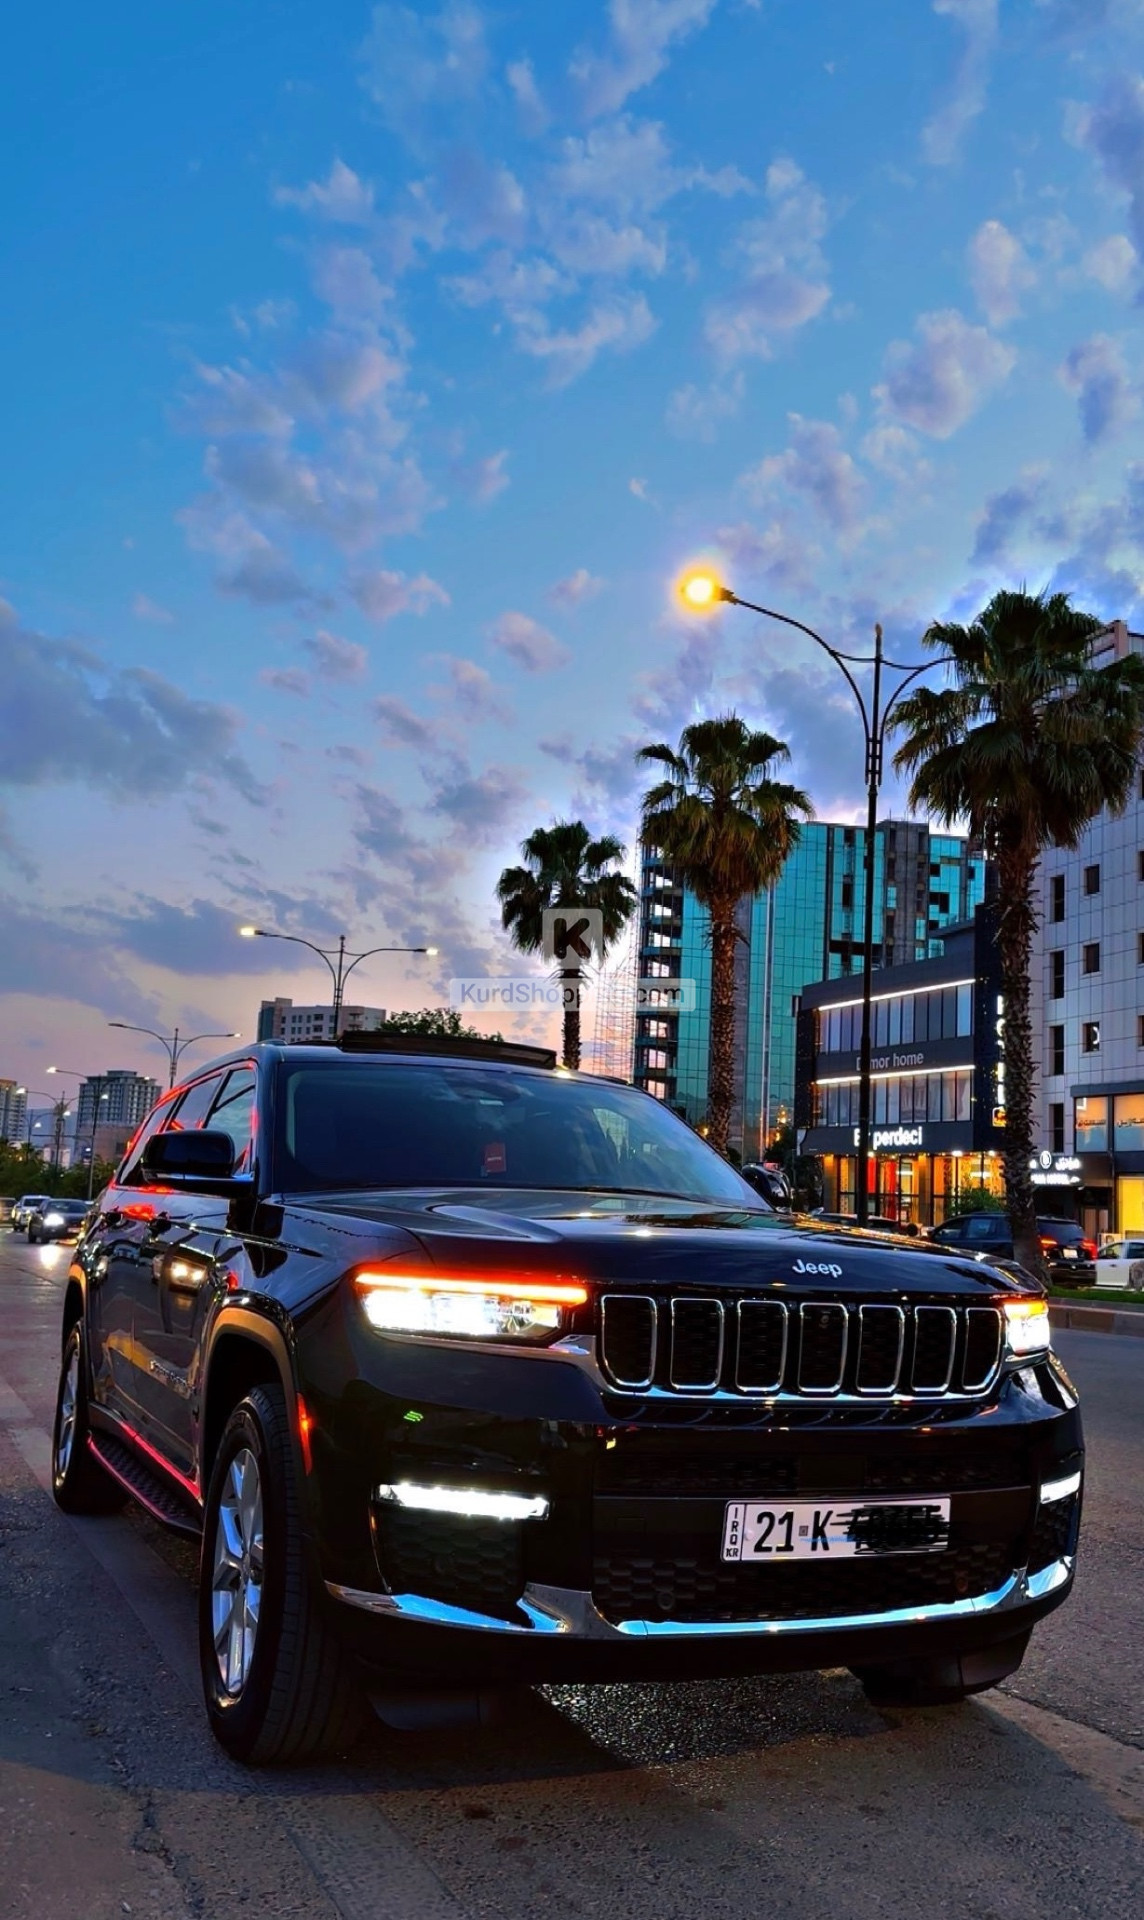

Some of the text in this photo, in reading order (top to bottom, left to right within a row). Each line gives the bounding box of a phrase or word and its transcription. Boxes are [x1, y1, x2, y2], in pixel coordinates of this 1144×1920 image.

[893, 1053, 924, 1067] home
[873, 1126, 923, 1150] perdeci
[792, 1258, 843, 1278] Jeep
[753, 1511, 794, 1553] 21
[810, 1510, 834, 1552] K
